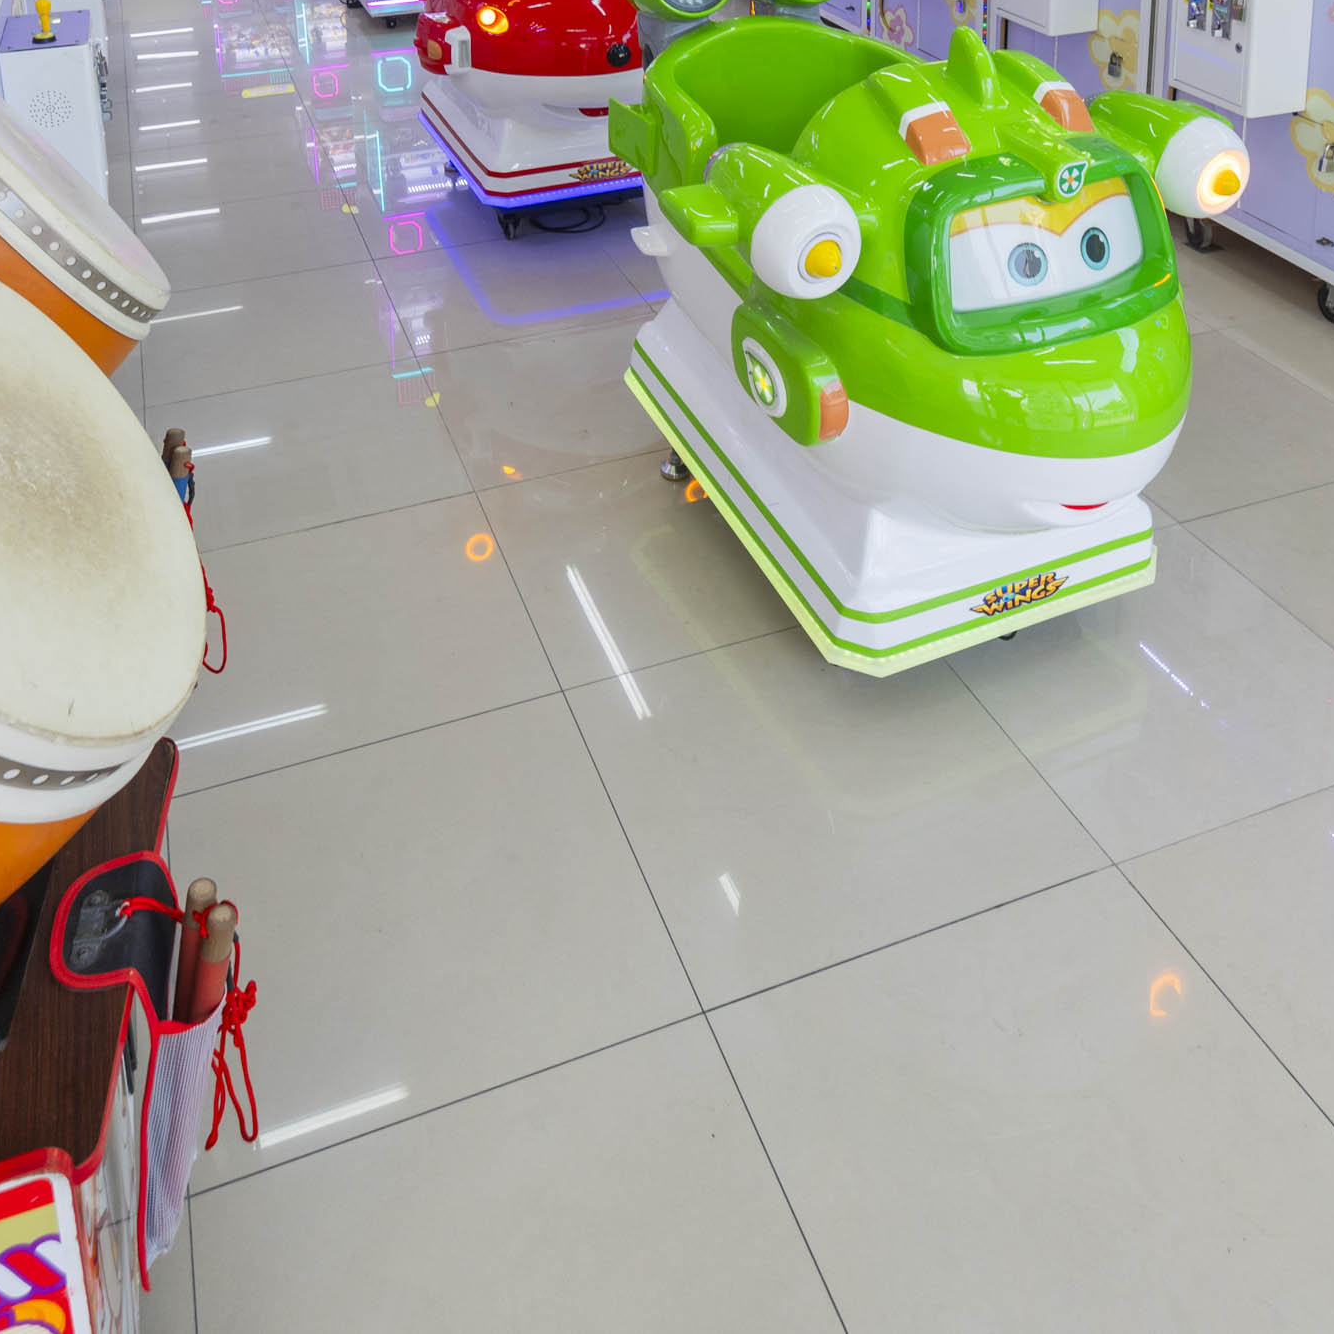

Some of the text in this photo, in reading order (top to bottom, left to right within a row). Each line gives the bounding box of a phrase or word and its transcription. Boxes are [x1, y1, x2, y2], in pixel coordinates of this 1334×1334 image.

[569, 165, 633, 182] WINGS
[581, 161, 627, 174] SUPER
[970, 577, 1069, 616] WINGS
[984, 572, 1056, 604] SUPER
